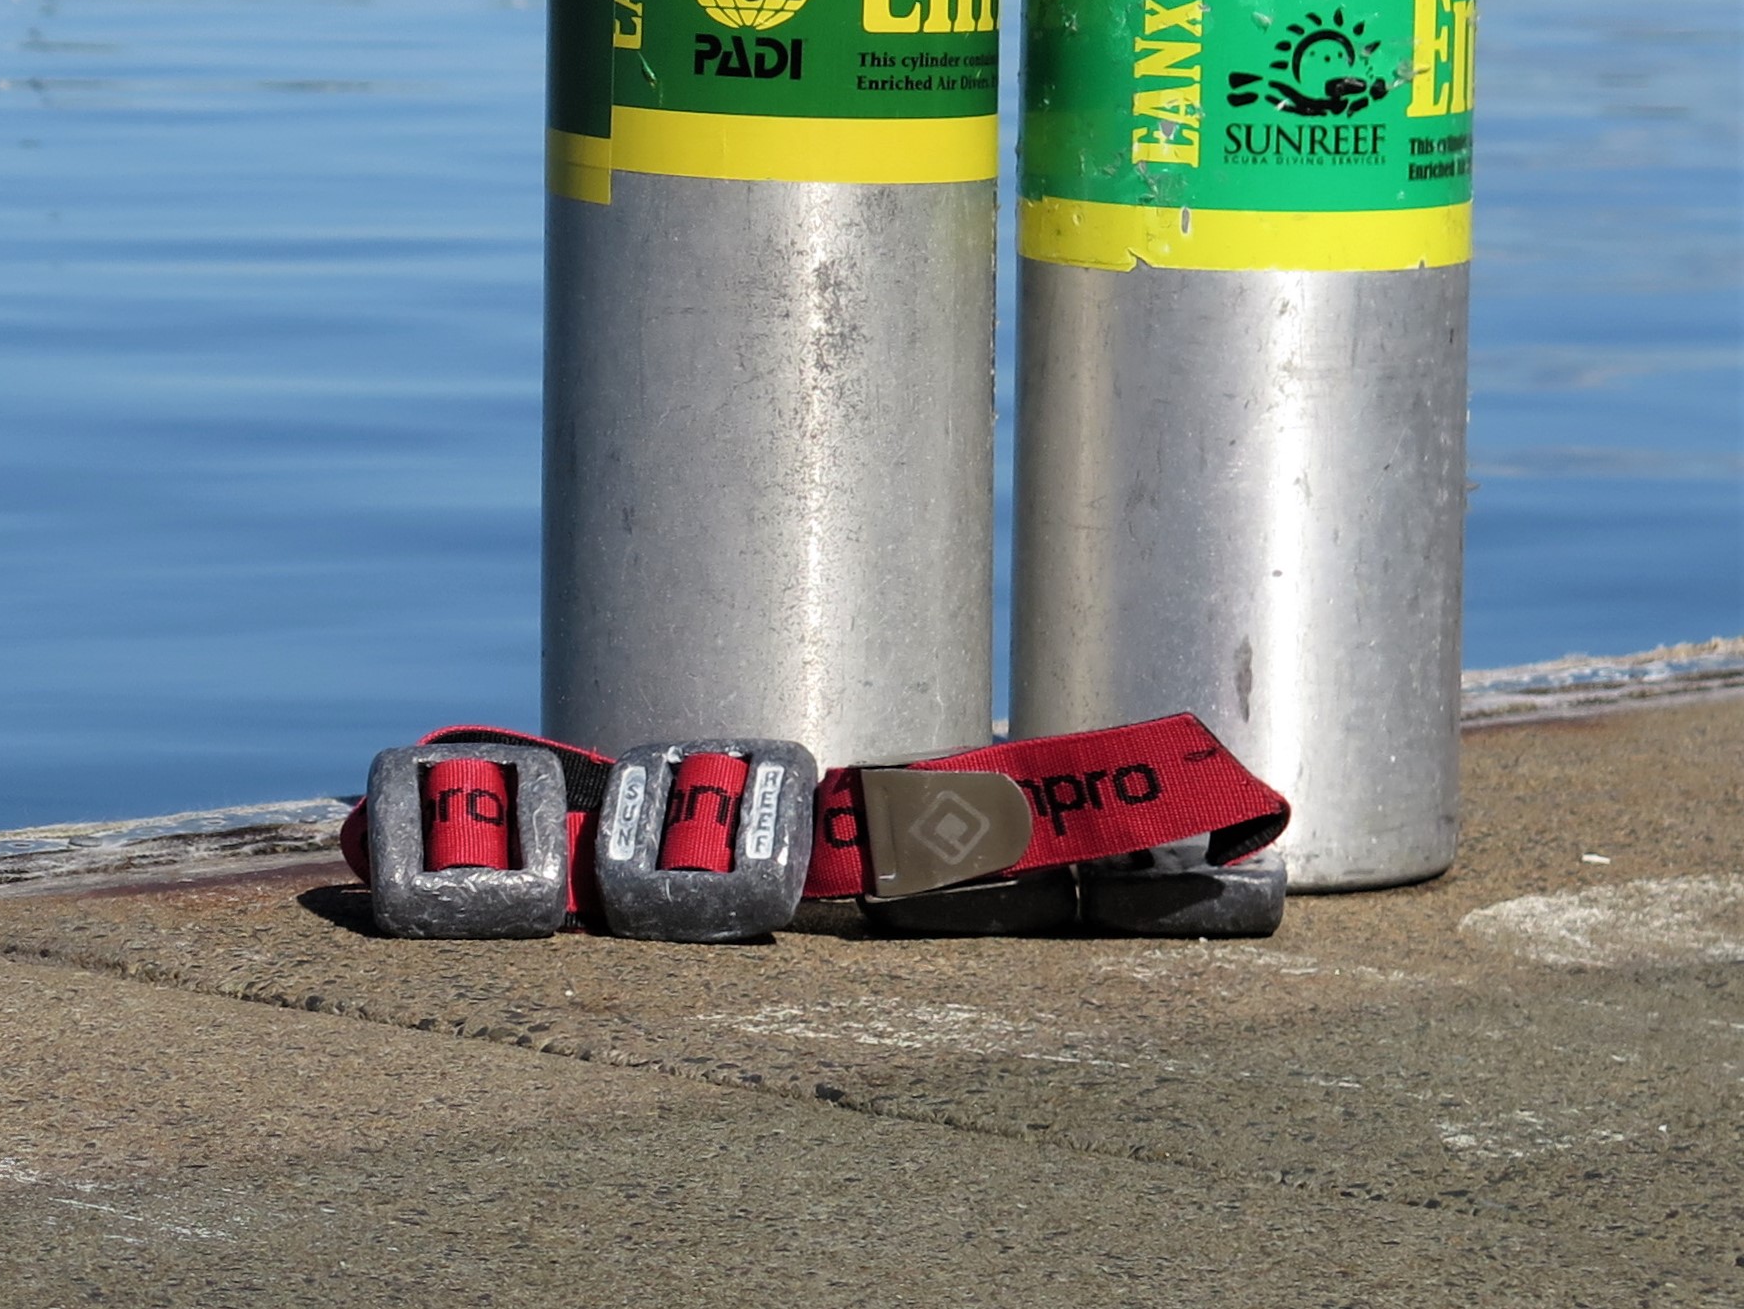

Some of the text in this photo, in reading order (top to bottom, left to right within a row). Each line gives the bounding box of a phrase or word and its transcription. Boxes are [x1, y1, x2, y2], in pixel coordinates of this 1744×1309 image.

[693, 33, 804, 80] PADI
[858, 52, 896, 68] This
[901, 52, 961, 72] cylinder
[856, 74, 933, 91] Enriched
[938, 76, 958, 90] Air
[1223, 123, 1387, 155] SUNREEF
[1223, 155, 1268, 165] SCUBA
[1275, 156, 1324, 166] DIVING
[756, 771, 780, 854] REEF
